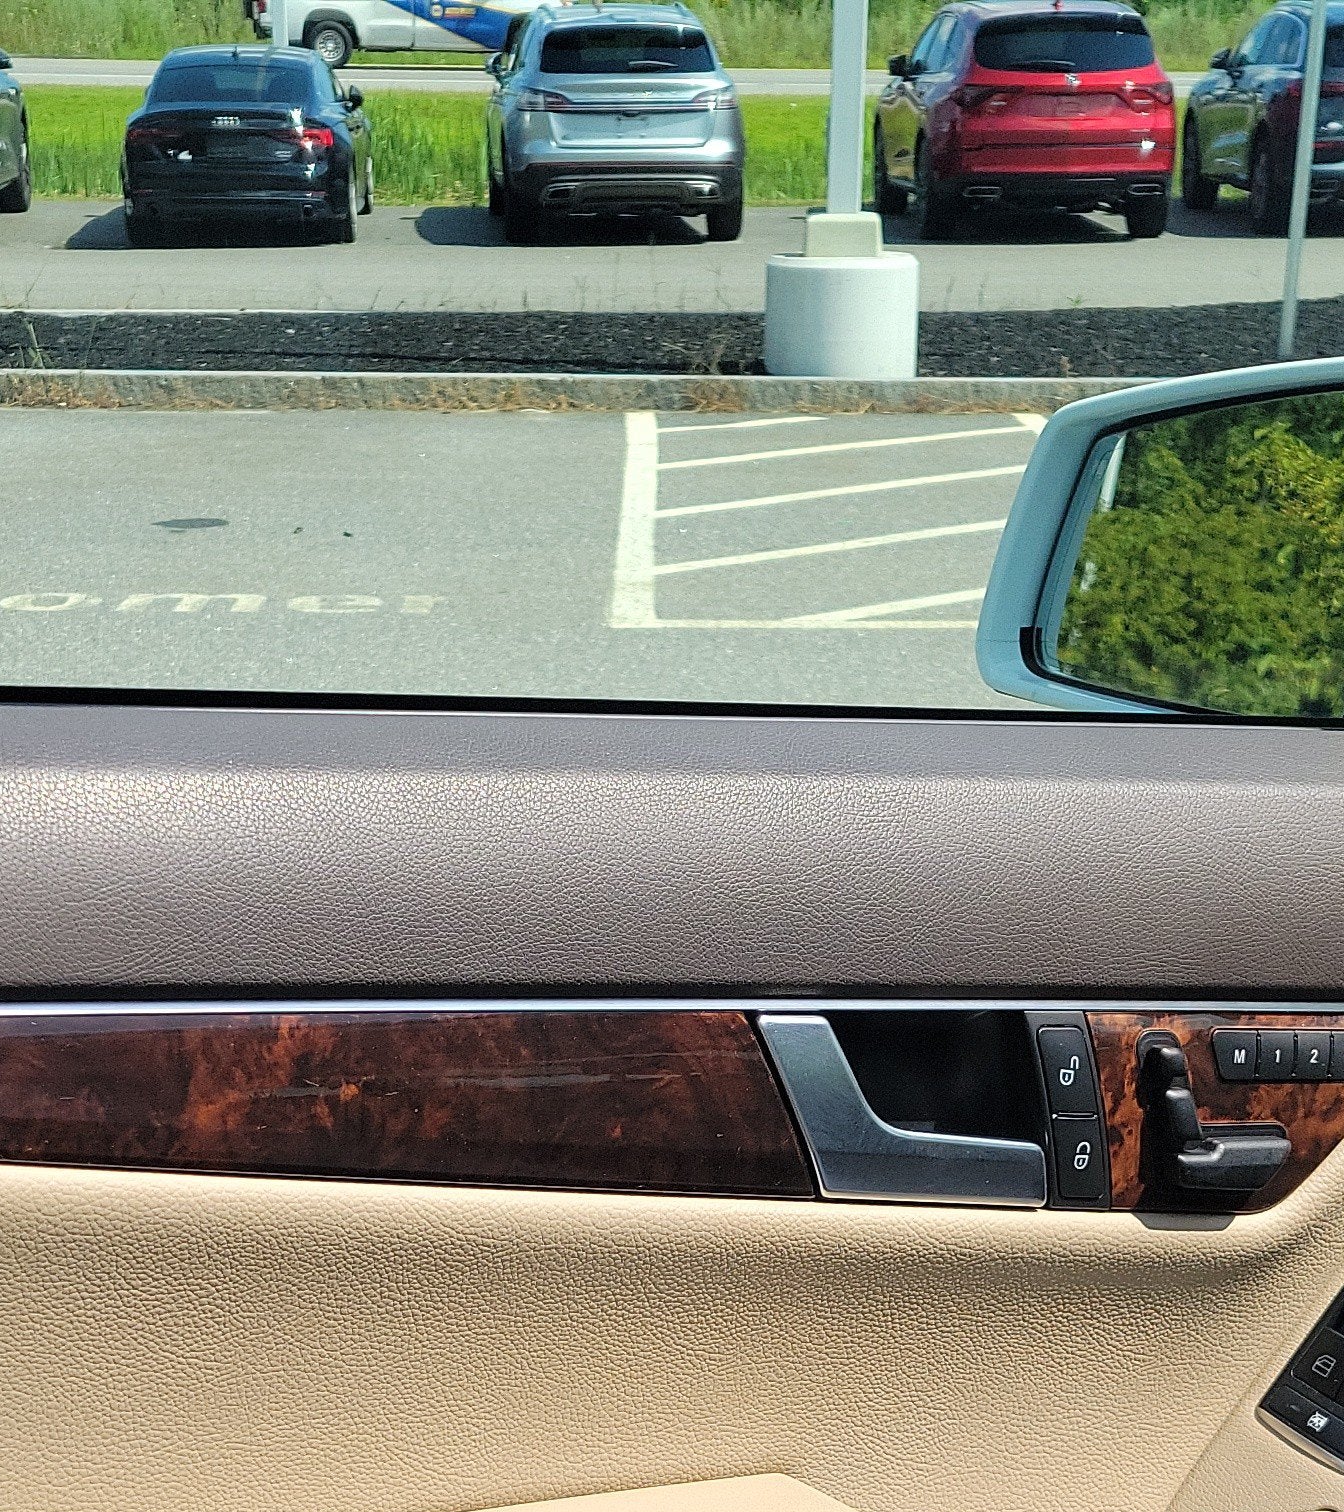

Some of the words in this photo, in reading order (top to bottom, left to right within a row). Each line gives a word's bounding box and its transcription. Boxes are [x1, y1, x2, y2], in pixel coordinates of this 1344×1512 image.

[1233, 1048, 1246, 1064] M
[1274, 1048, 1282, 1064] 1
[1309, 1048, 1319, 1064] 2
